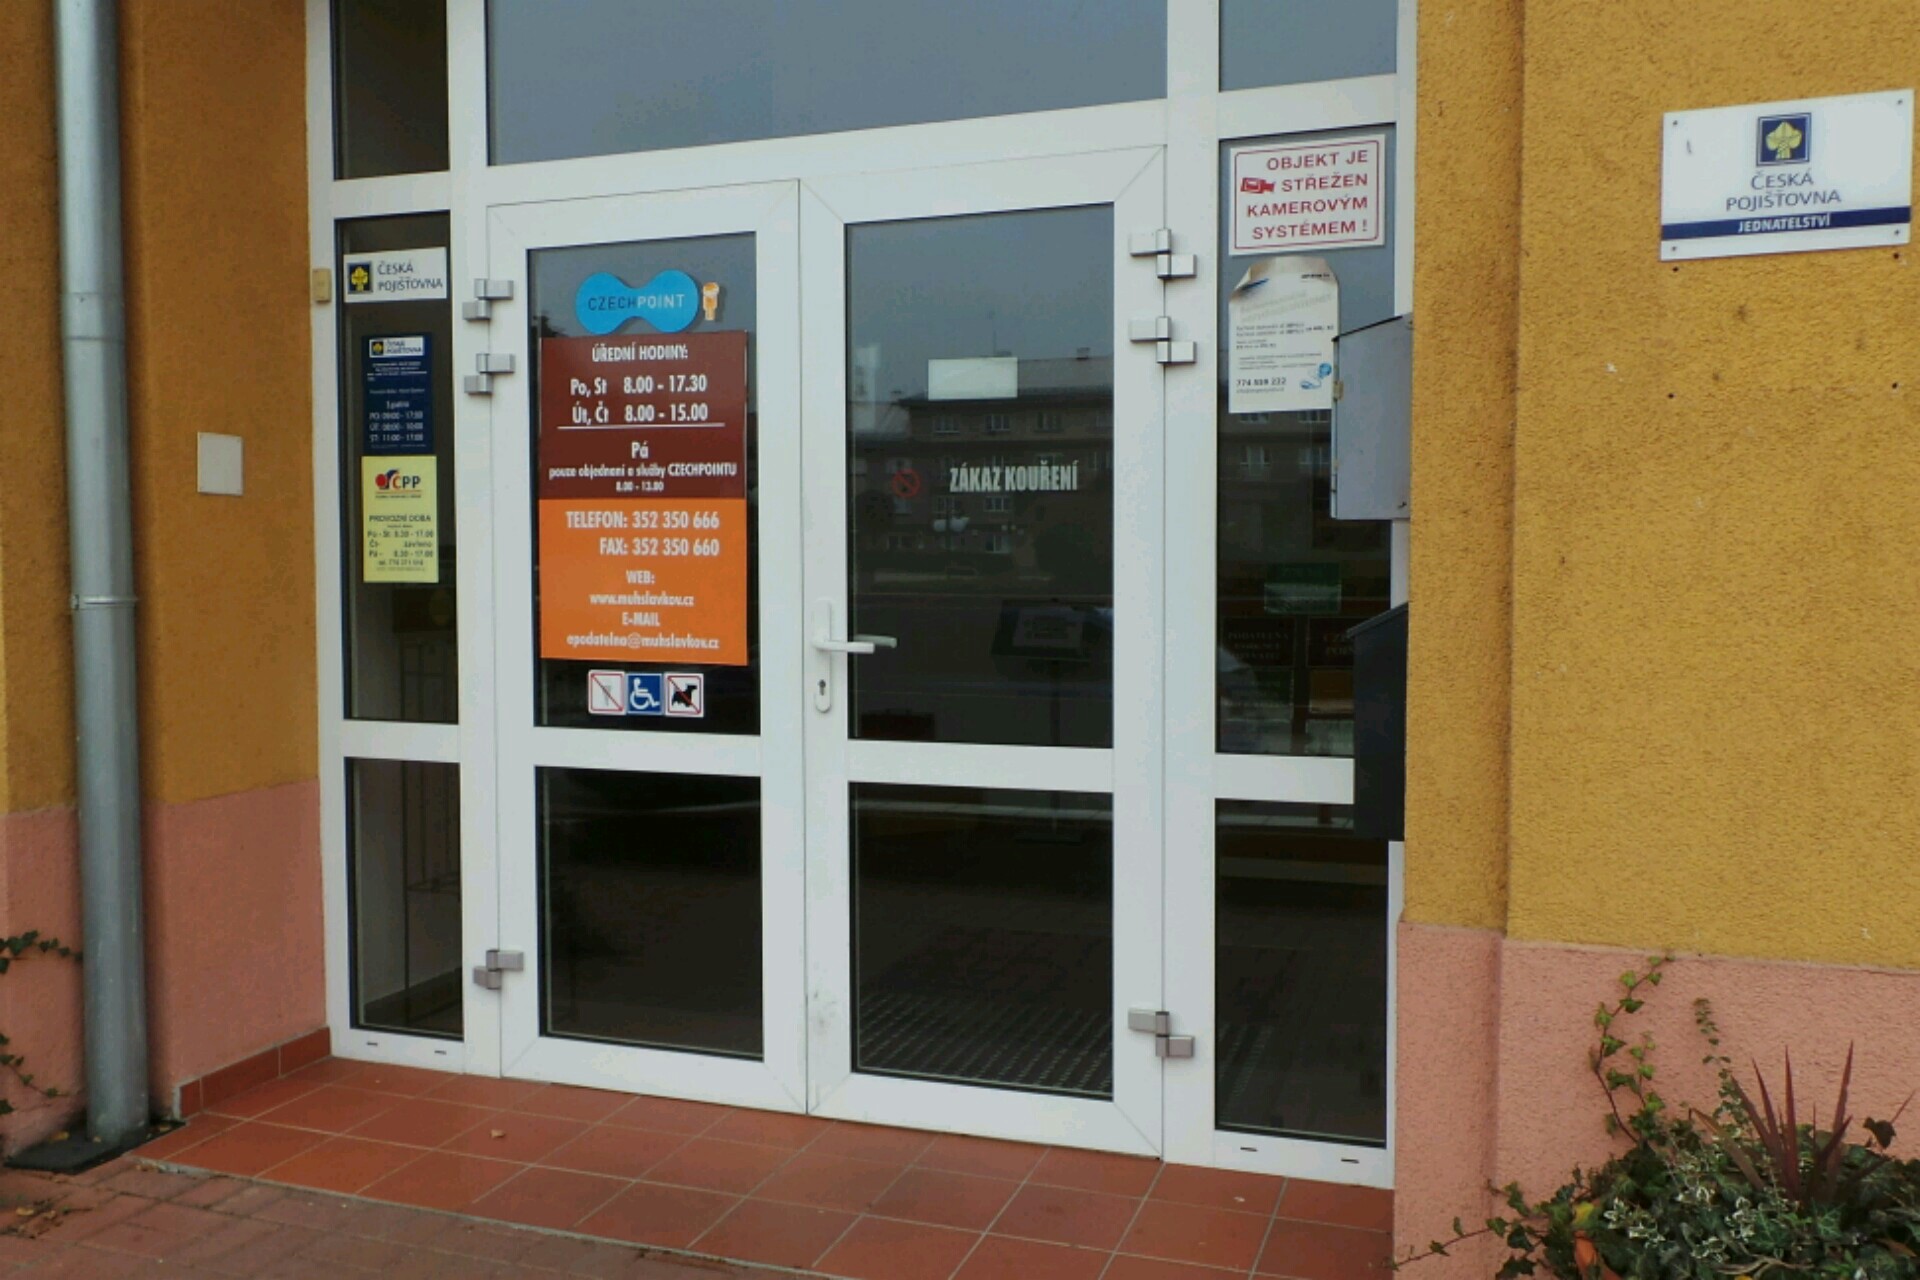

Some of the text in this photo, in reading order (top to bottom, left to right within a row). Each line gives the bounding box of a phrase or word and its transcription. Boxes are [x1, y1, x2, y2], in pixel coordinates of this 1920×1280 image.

[1266, 149, 1369, 171] OBJEKT JE
[1281, 172, 1368, 193] STŘEŽEN
[1751, 169, 1815, 191] ČESKÁ
[1246, 194, 1368, 218] KAMEROVÝM
[1725, 189, 1842, 213] POJIŠŤOVNA
[1252, 218, 1356, 240] SYSTÉMEM
[1737, 211, 1832, 234] JEDNATELSTVÍ
[377, 259, 414, 276] ČESKÁ
[377, 276, 444, 293] POJIŠŤOVNA
[591, 341, 689, 363] ÚŘEDNÍ HODINY:
[570, 378, 592, 398] Po,
[594, 376, 608, 395] St
[623, 375, 654, 394] 8.00
[668, 374, 708, 393] 17.30
[572, 400, 592, 426] Út,
[594, 400, 610, 424] Čt
[624, 404, 655, 423] 8.00
[669, 402, 709, 422] 15.00
[631, 440, 649, 459] Pá
[549, 467, 576, 480] pouze
[636, 462, 667, 478] služby
[667, 461, 738, 477] CZECHPOINTU
[949, 459, 1080, 493] ZÁKAZ KOUŘENÍ
[565, 510, 720, 529] TELEFON: 352 350 666
[599, 537, 720, 557] FAX: 352 350 660
[626, 570, 656, 585] WEB:
[621, 611, 661, 627] E-MAIL
